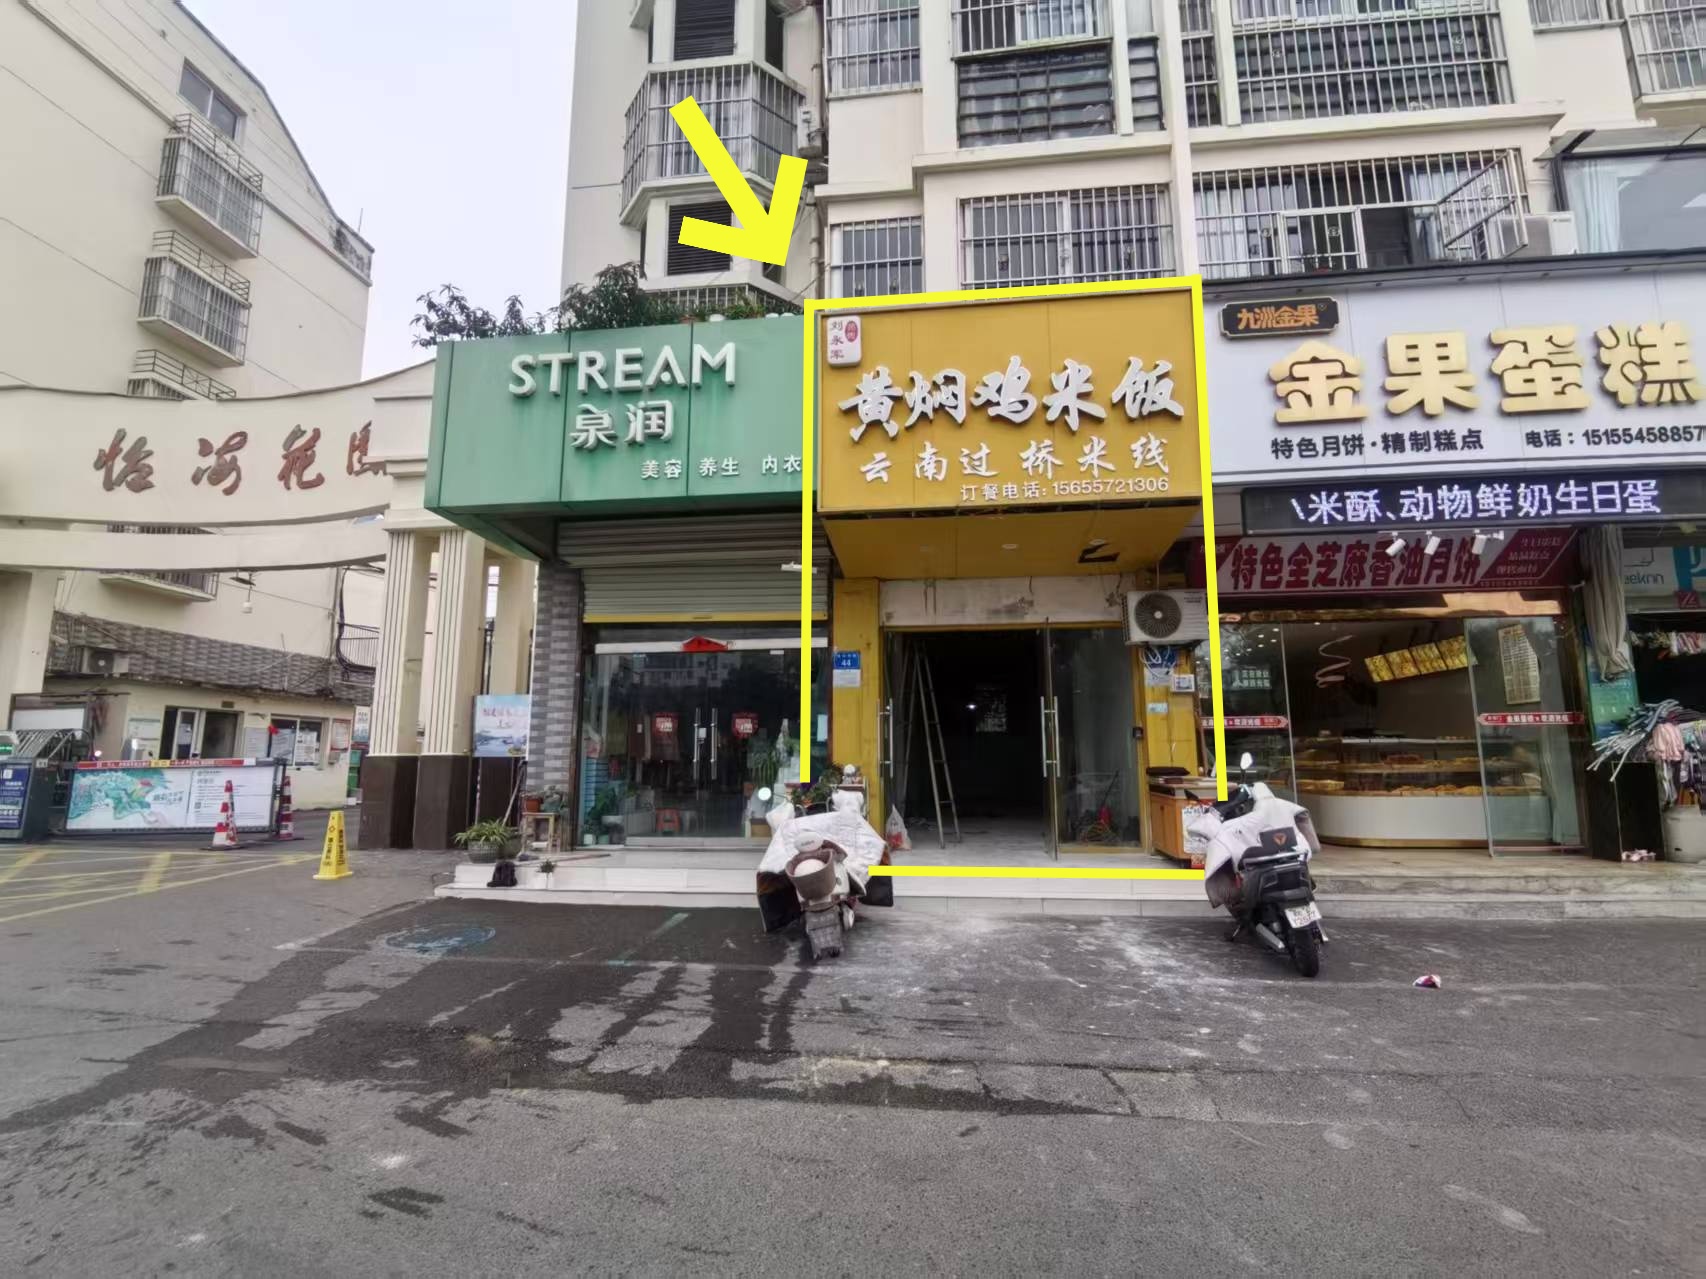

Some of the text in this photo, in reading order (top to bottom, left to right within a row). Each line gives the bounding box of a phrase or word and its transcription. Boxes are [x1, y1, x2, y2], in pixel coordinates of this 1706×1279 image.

[1237, 303, 1320, 330] 九洲金果
[508, 342, 736, 399] STREAM
[1267, 320, 1704, 426] 金果蛋糕
[838, 355, 1185, 443] 黄焖鸡米饭
[569, 400, 676, 450] 泉润
[1271, 427, 1484, 459] 特色月饼·精制糕点
[640, 453, 803, 480] 美容 养生 内衣
[859, 432, 1169, 482] 云南过桥米线
[1291, 479, 1661, 524] 米酥、动物鲜奶生日蛋
